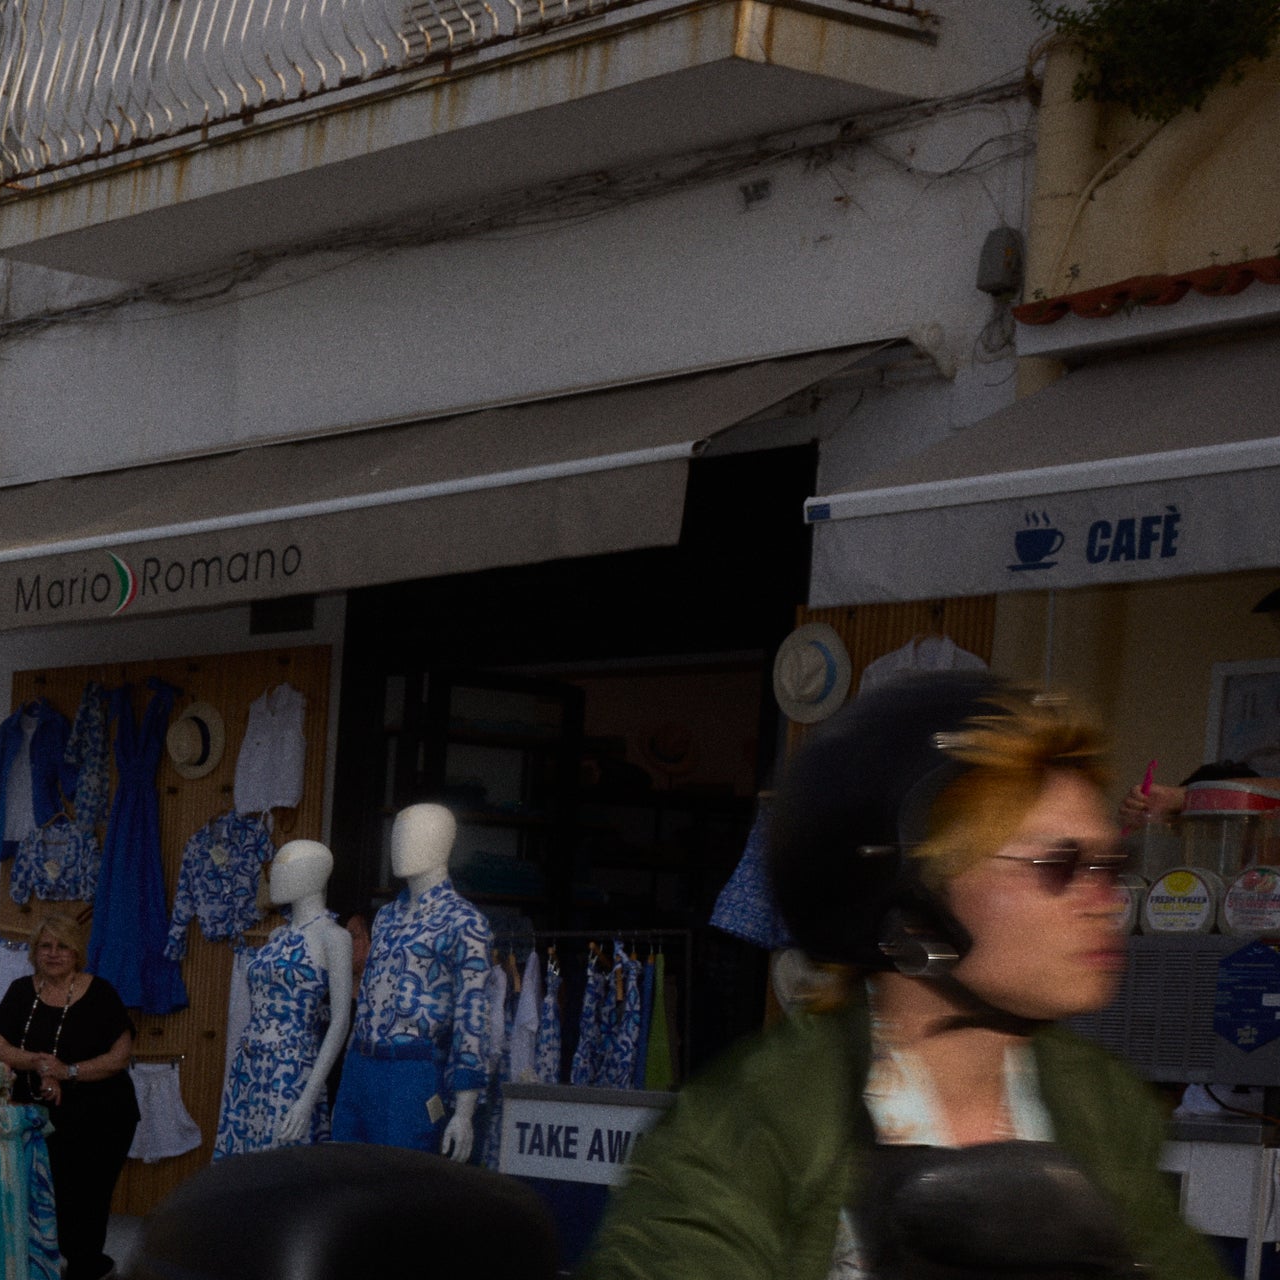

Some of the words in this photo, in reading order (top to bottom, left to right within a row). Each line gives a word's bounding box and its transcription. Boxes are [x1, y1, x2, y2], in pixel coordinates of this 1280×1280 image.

[1086, 505, 1181, 563] CAFÈ
[15, 568, 111, 613] Mario
[141, 545, 302, 596] Romano
[516, 1122, 579, 1159] TAKE
[587, 1128, 643, 1164] AW
